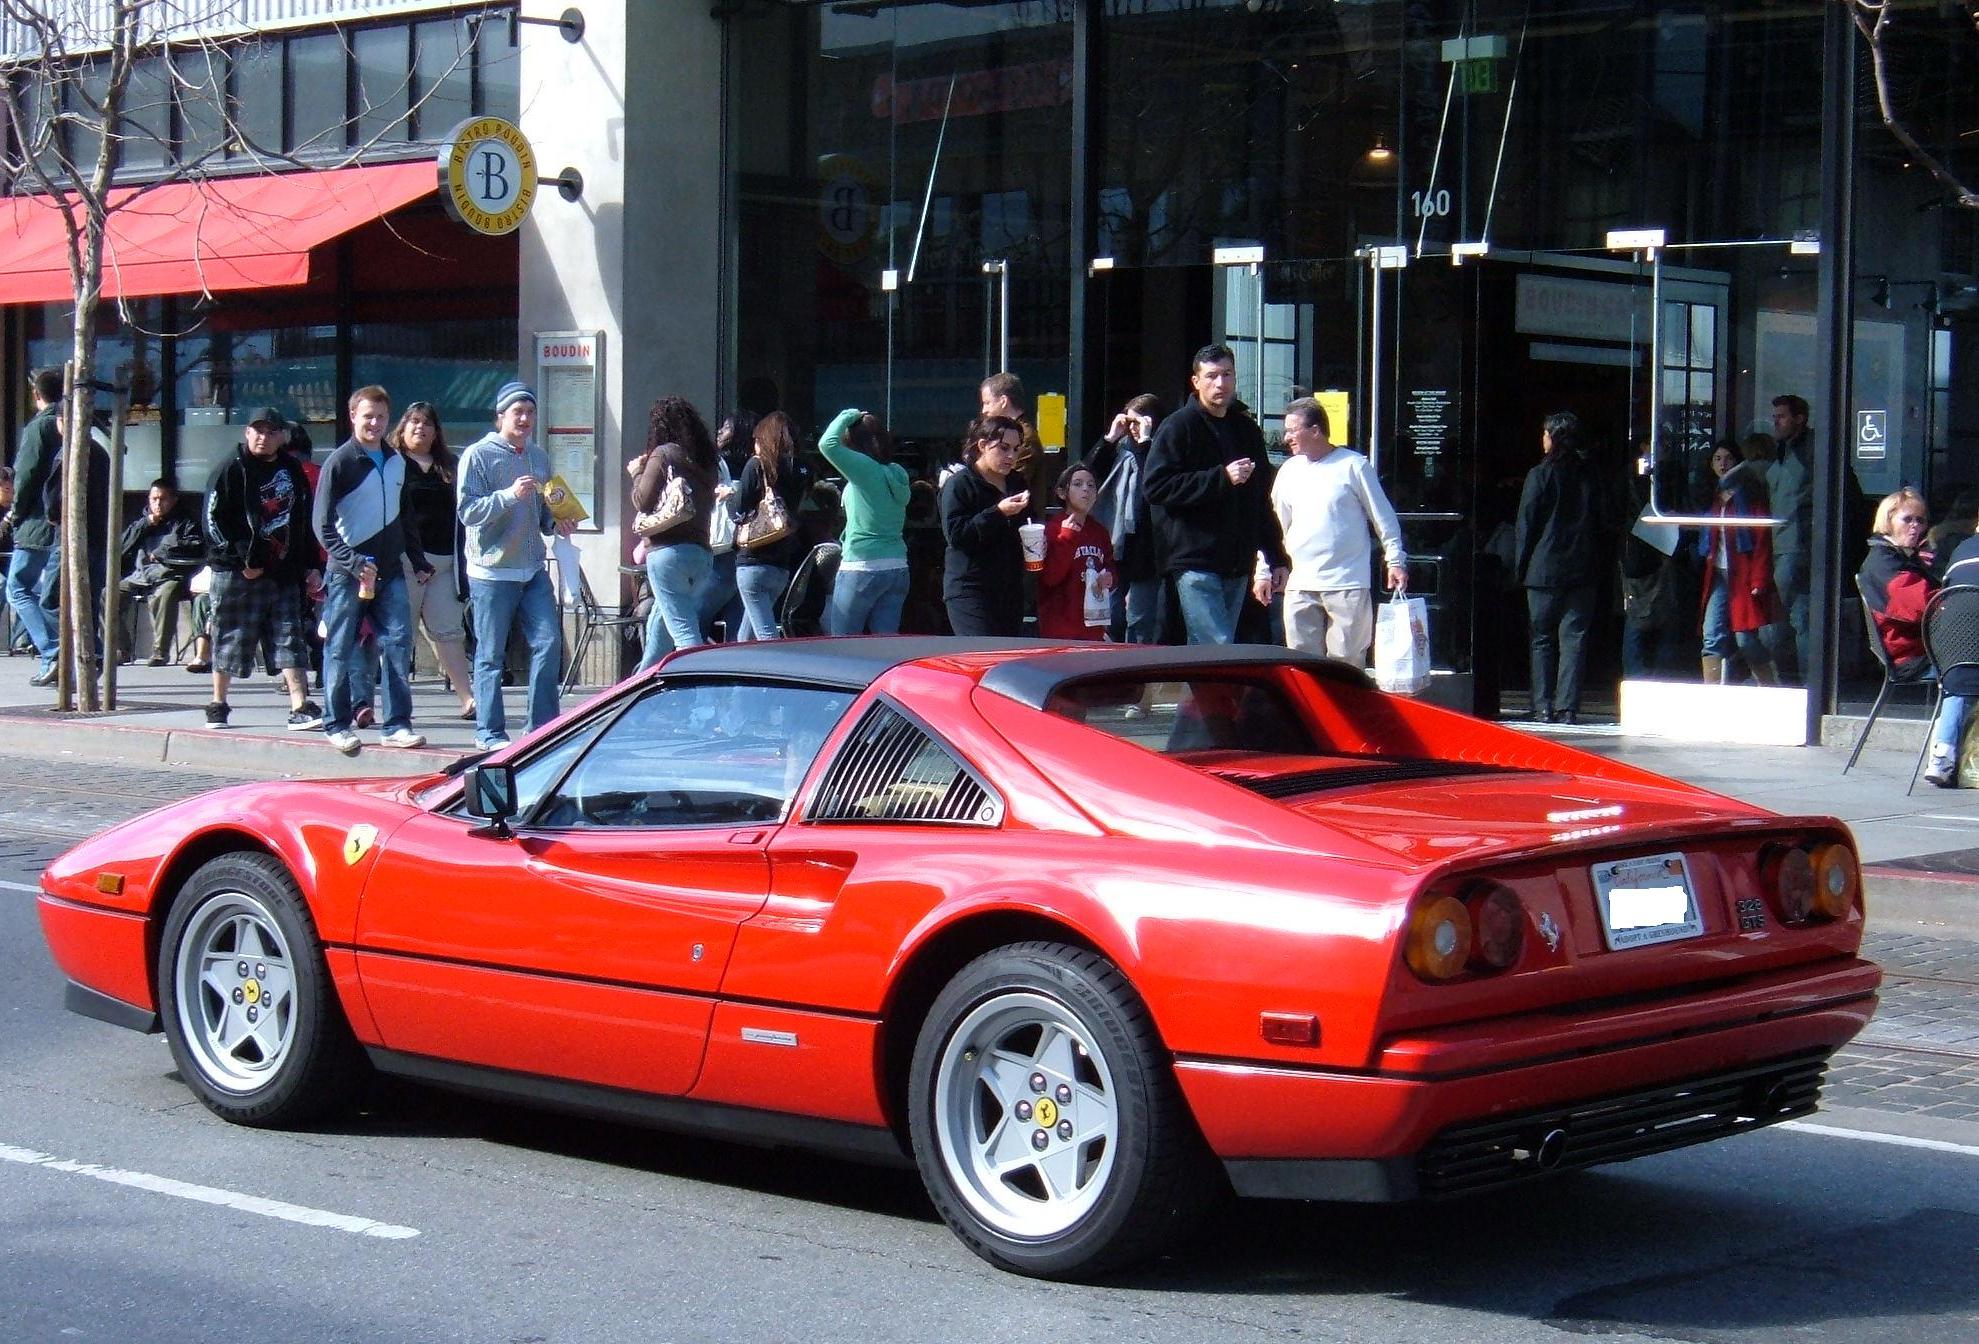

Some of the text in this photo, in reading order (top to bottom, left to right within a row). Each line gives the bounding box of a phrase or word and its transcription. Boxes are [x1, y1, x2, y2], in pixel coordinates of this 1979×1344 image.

[454, 123, 489, 163] BISTRO
[480, 151, 509, 200] B
[454, 184, 532, 229] BISTRO BOUDIN
[1411, 190, 1450, 217] 160
[543, 345, 591, 358] BOUDIN
